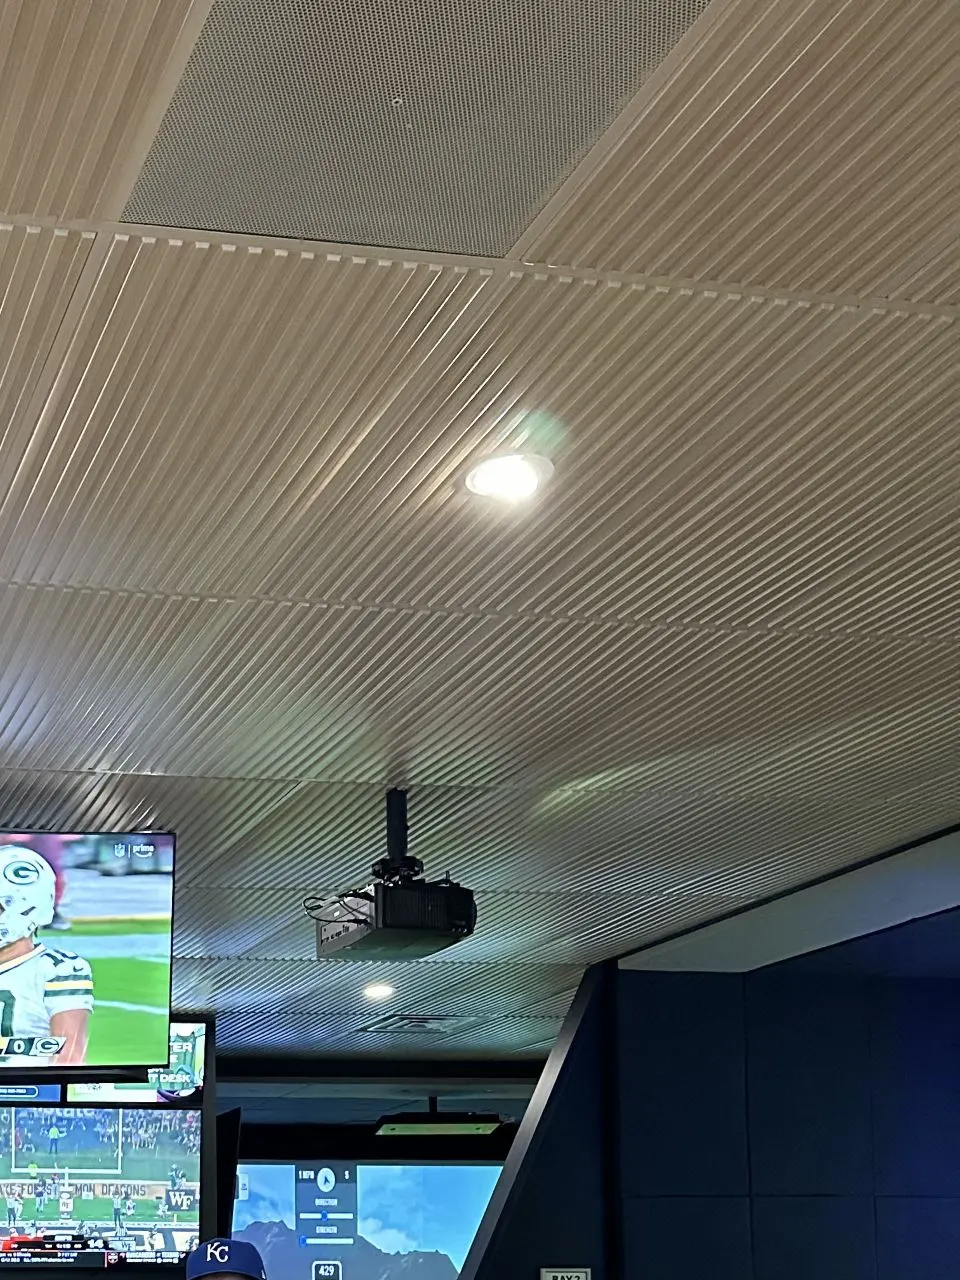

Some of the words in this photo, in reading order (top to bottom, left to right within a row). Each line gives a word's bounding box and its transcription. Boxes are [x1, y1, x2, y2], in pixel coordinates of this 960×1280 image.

[133, 844, 154, 853] prime
[14, 1040, 25, 1054] 0
[160, 1074, 190, 1083] DESK
[169, 1190, 194, 1212] WF
[86, 1239, 104, 1249] 14
[206, 1241, 229, 1263] KC
[318, 1264, 335, 1276] 429
